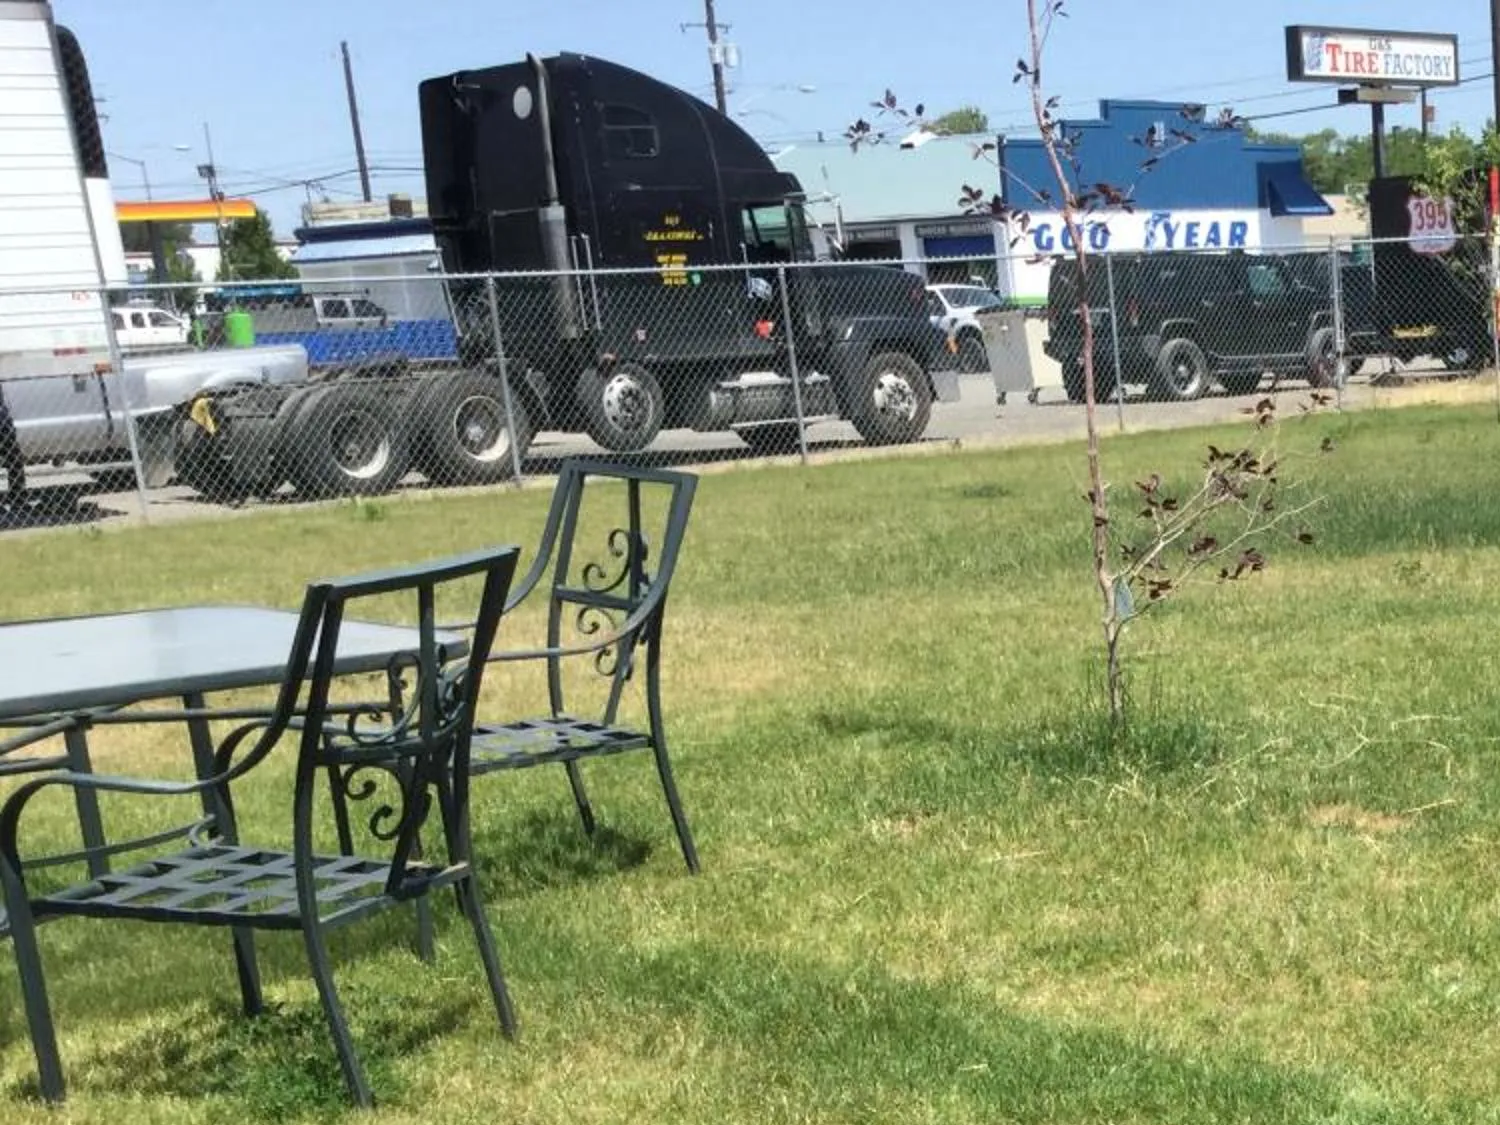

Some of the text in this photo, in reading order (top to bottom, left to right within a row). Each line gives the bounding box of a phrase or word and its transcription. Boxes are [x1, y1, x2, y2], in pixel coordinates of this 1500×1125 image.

[1325, 43, 1452, 77] TIRE FACTORY
[1413, 201, 1447, 231] 395
[1162, 220, 1248, 248] YEAR
